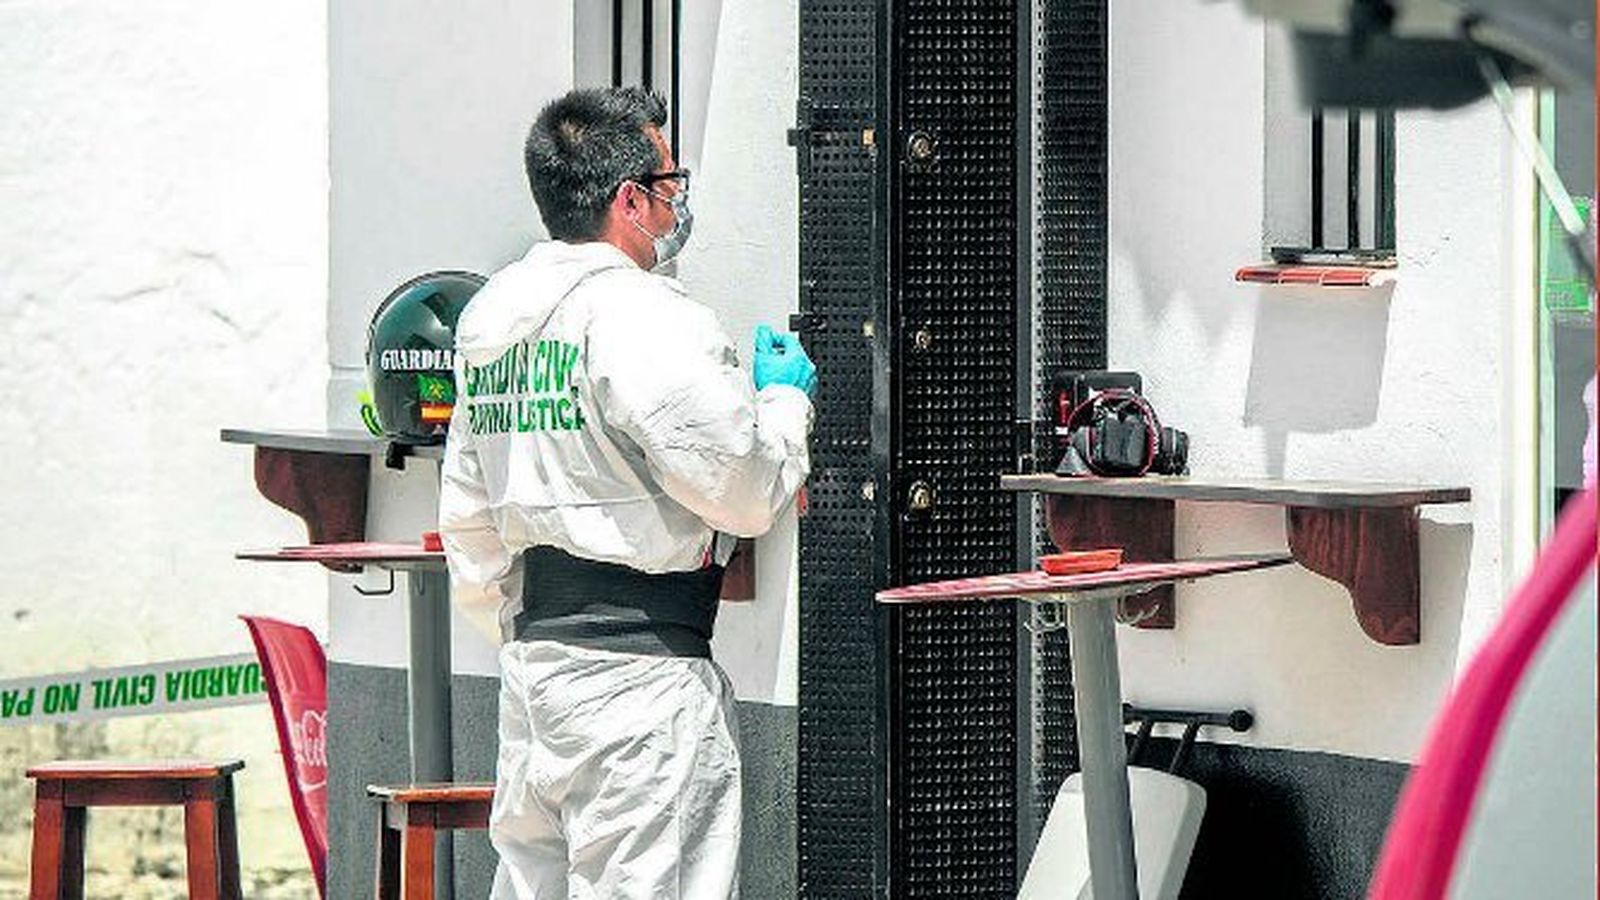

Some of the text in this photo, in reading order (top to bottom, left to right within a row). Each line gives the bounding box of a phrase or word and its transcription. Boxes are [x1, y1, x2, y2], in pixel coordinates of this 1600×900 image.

[380, 349, 455, 371] GUARDIA
[43, 683, 81, 715] NO
[91, 674, 156, 710] CIVIL
